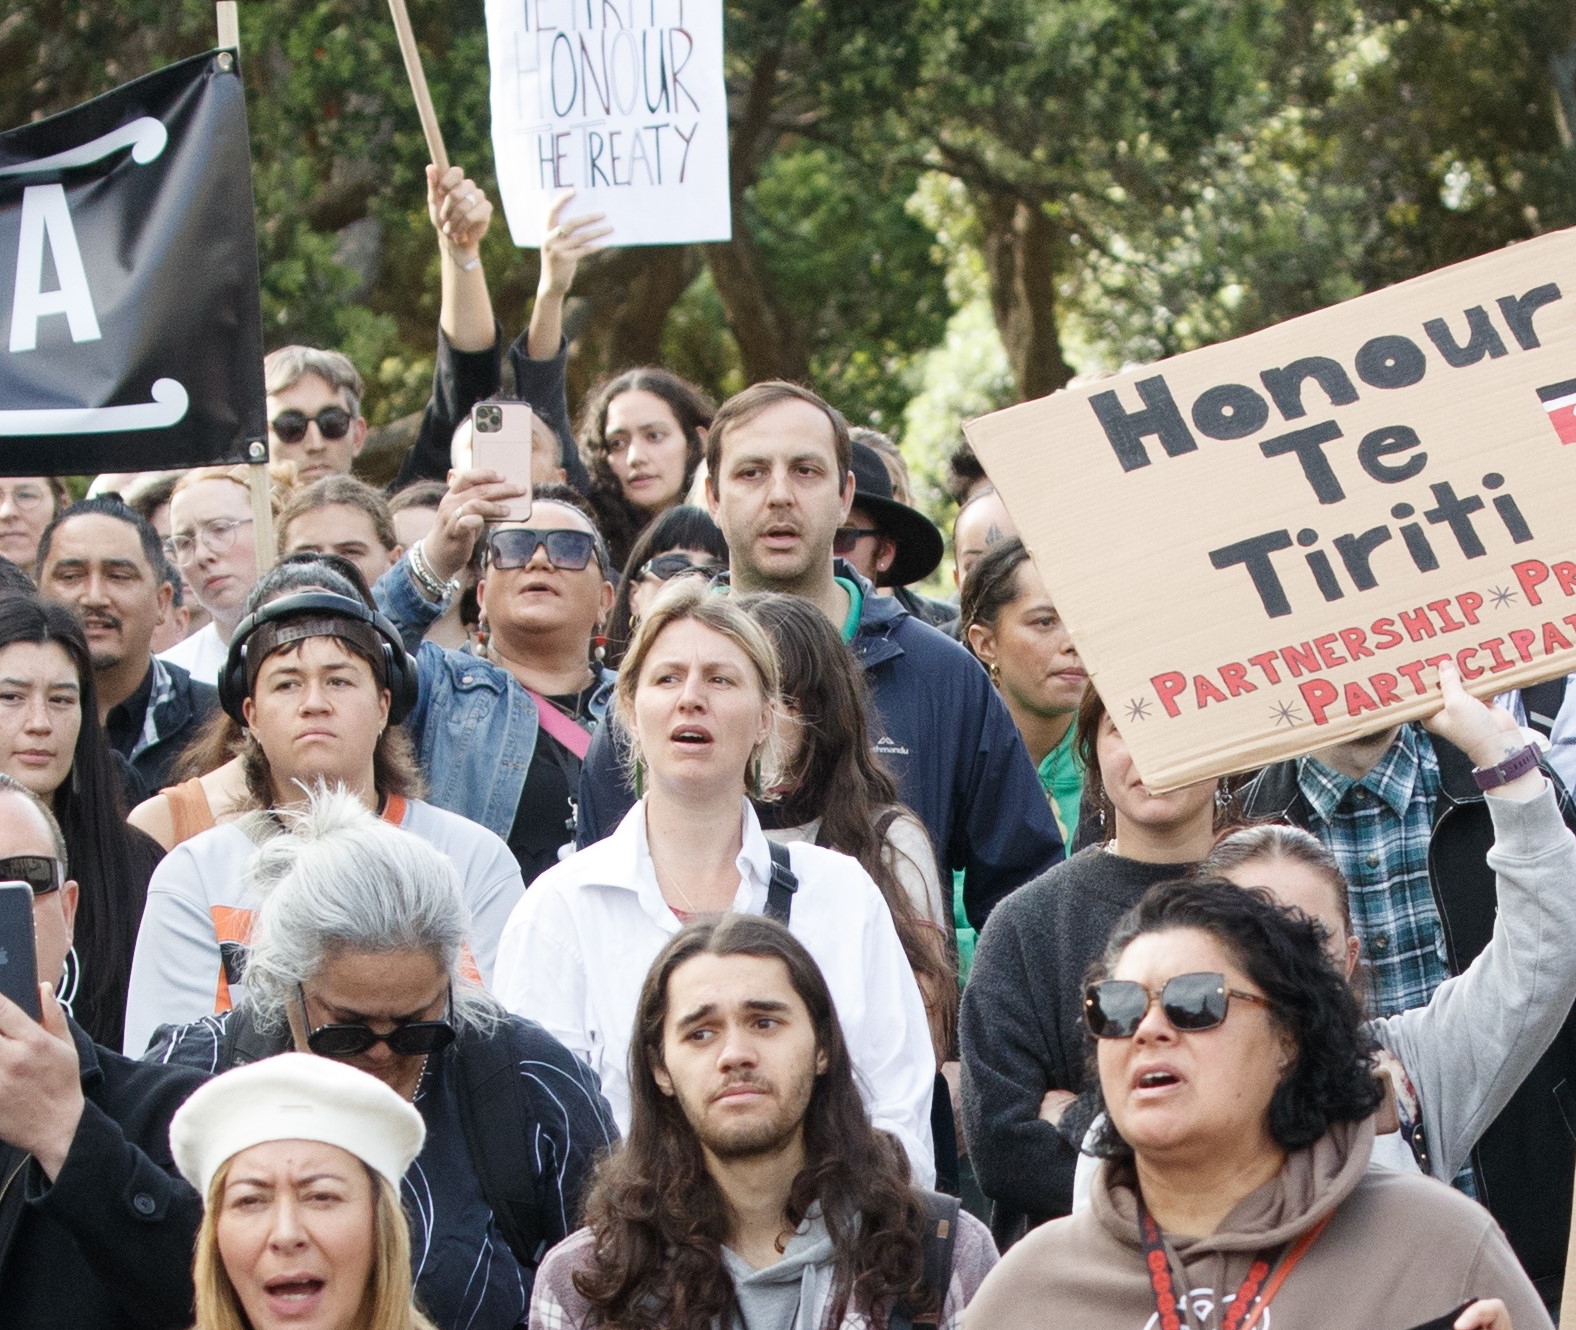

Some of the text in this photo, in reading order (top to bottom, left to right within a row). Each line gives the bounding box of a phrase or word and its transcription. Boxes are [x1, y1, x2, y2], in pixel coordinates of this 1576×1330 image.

[514, 28, 701, 120] HONOUR
[515, 119, 699, 190] THE TREATY
[1088, 282, 1562, 473] Honour
[1259, 419, 1428, 505] Te
[1208, 472, 1535, 618] Tiriti
[1150, 591, 1484, 718] PARTNERSHIP
